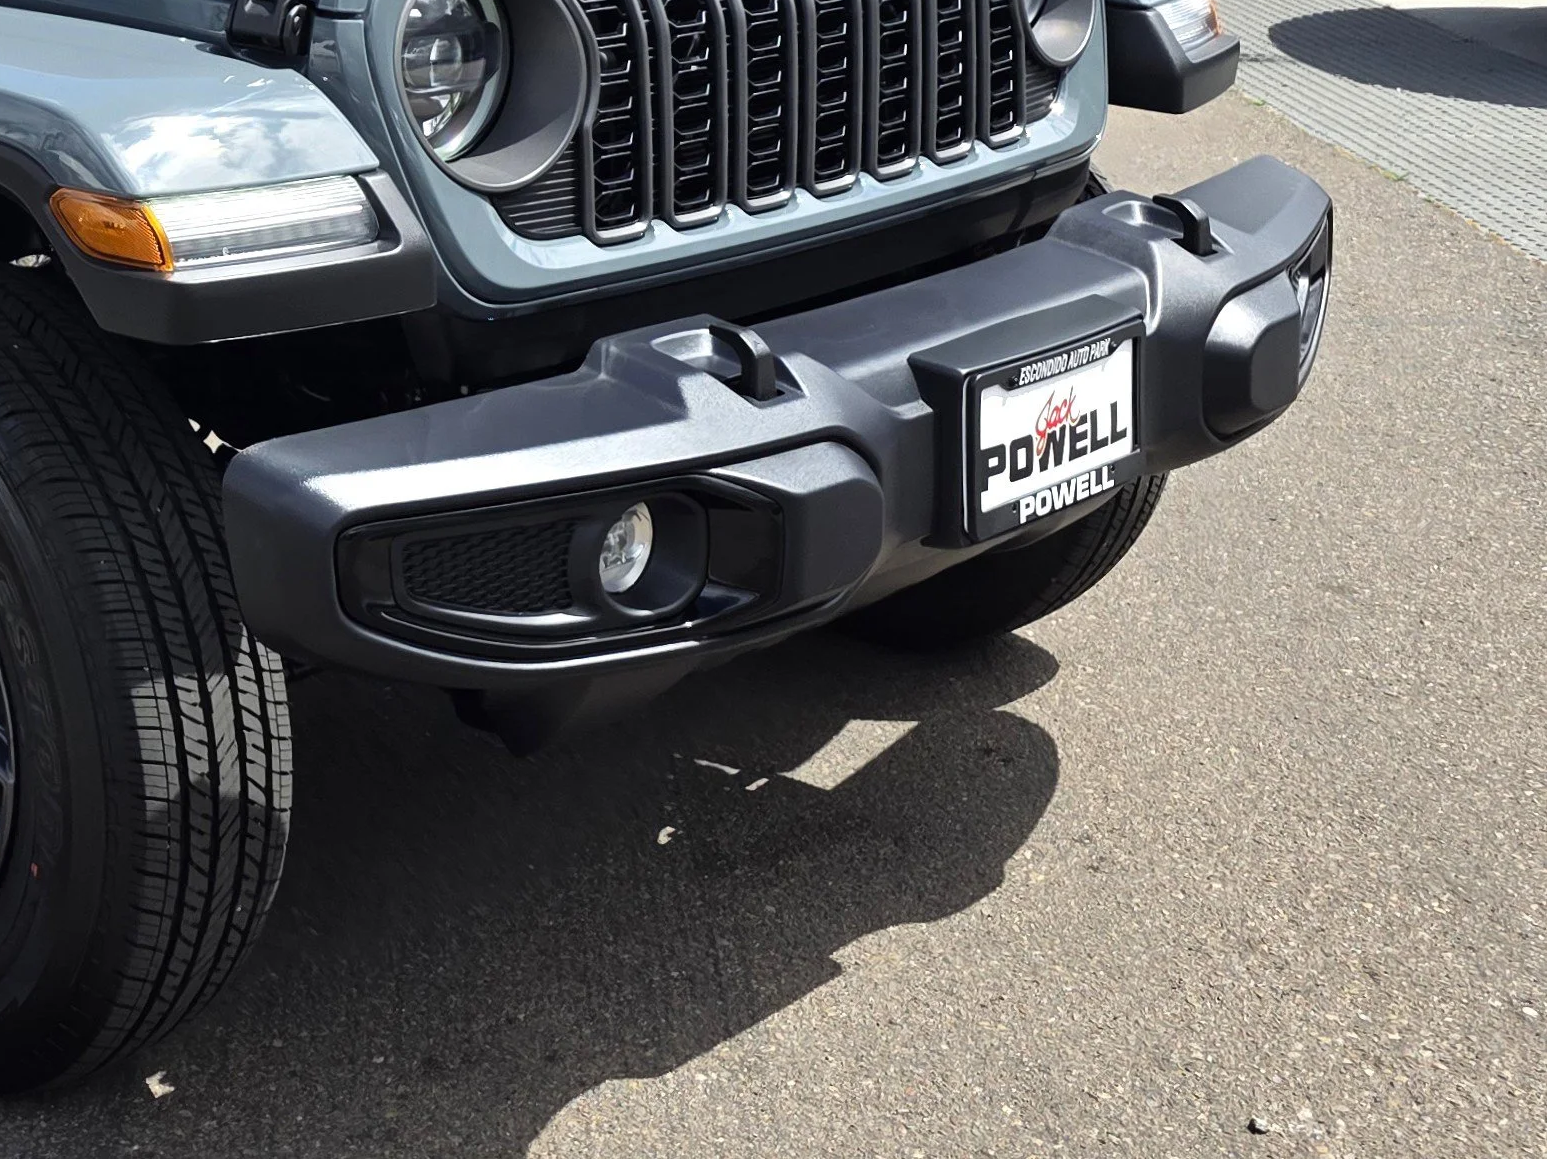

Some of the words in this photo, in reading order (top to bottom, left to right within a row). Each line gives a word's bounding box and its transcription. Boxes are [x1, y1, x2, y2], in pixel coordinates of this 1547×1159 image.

[1019, 354, 1068, 386] ESCONDIDO
[1067, 345, 1090, 369] AUTO
[1089, 338, 1111, 362] PARK
[980, 401, 1128, 492] POWELL
[1035, 385, 1081, 456] Jack
[1019, 466, 1115, 525] POWELL
